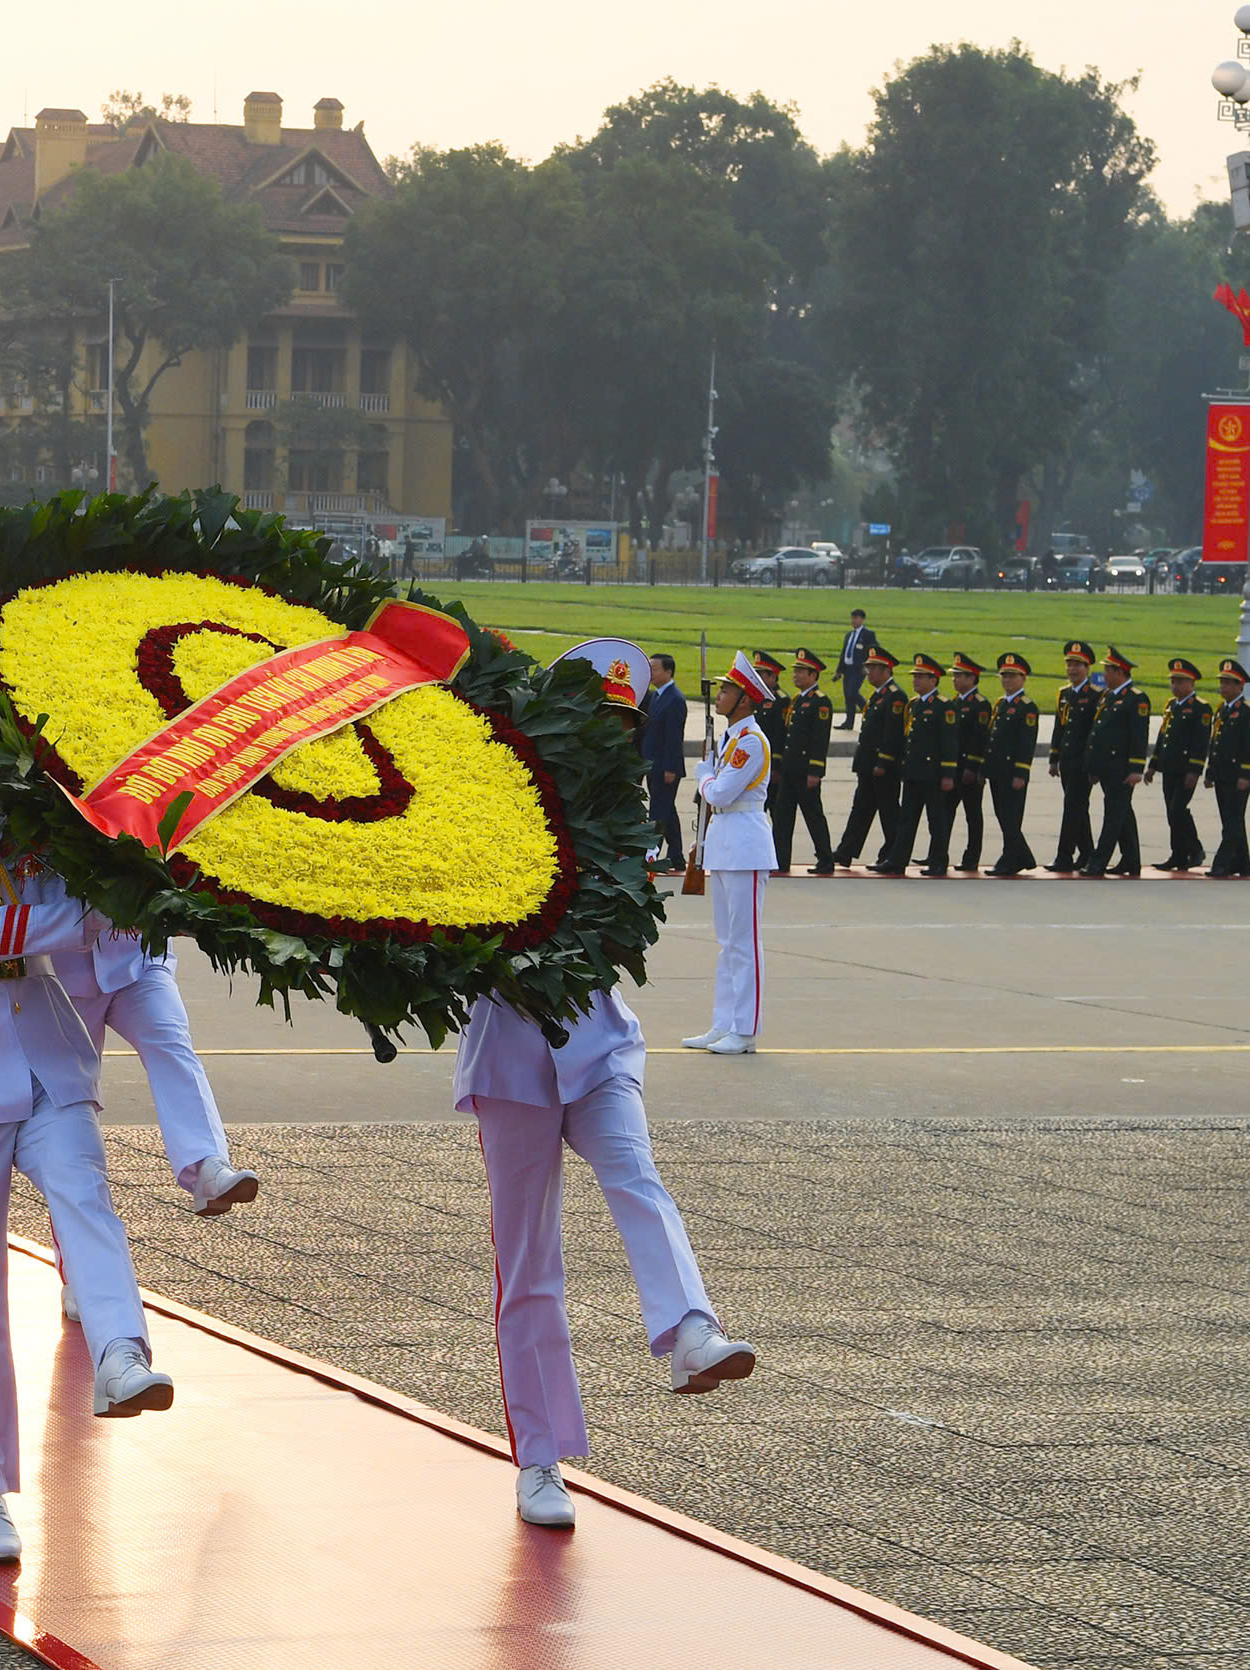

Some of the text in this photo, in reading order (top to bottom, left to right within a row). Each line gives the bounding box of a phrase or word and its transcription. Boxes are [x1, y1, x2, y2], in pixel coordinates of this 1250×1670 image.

[282, 662, 326, 691] CHÍ
[300, 655, 356, 682] MINH
[236, 685, 287, 714] TỊCH
[264, 670, 305, 700] HỒ
[211, 699, 262, 733] CHỦ
[191, 724, 237, 748] ƠN
[162, 734, 216, 768] NHỚ
[194, 778, 228, 798] BAN
[211, 761, 247, 784] CHẤP
[231, 745, 270, 767] HÀNH
[251, 727, 292, 748] TRUNG
[134, 756, 190, 785] ĐỜI
[115, 774, 167, 804] ĐỜI
